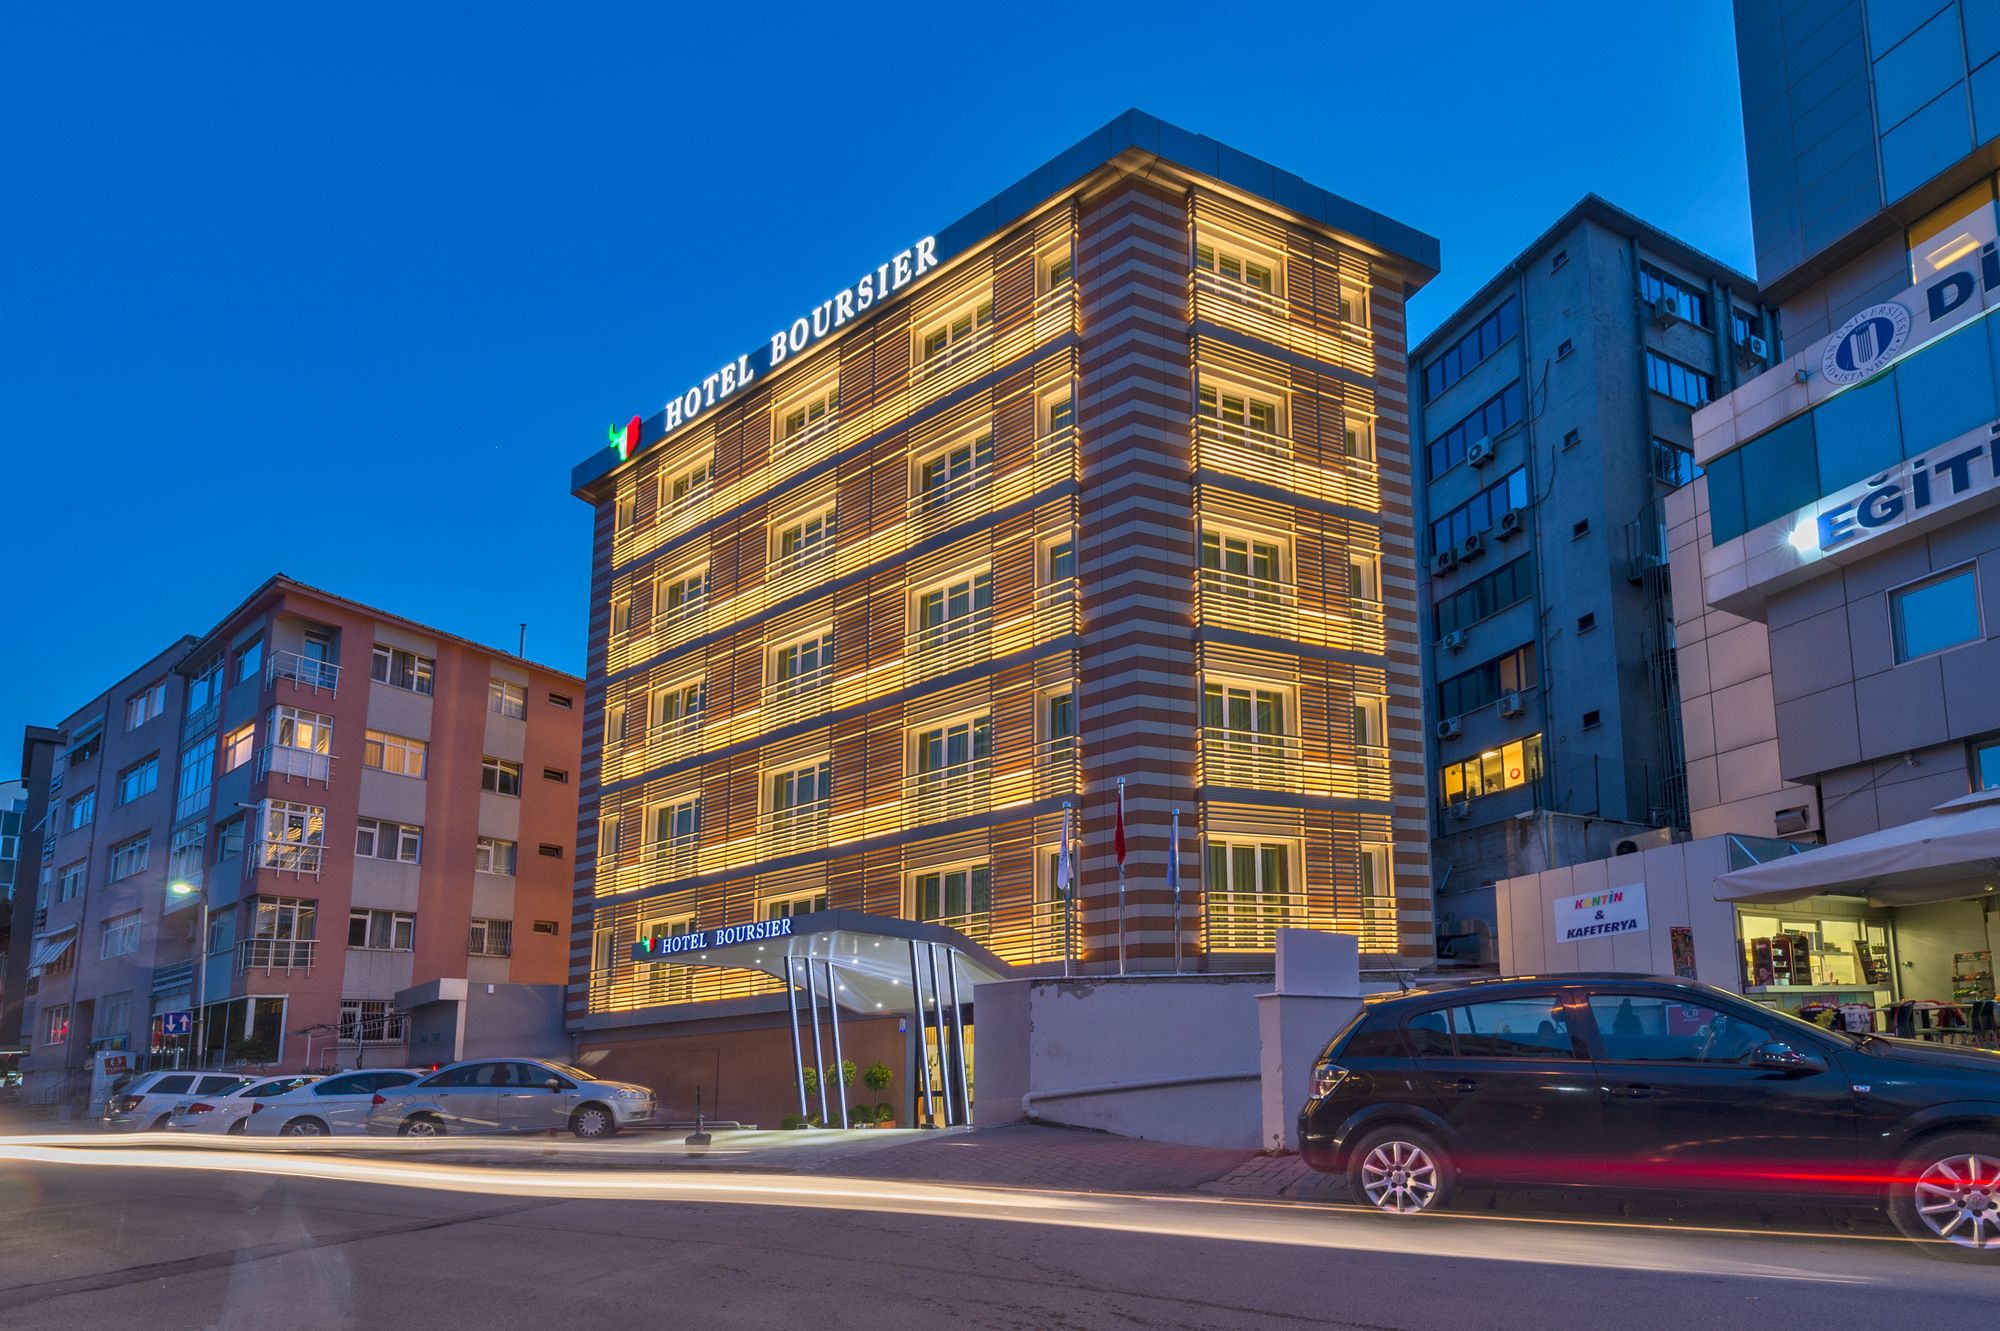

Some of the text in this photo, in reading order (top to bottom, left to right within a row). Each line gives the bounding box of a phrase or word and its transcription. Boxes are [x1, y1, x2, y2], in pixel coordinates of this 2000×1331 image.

[664, 235, 938, 432] HOTEL BOURSIER
[1574, 890, 1624, 910] KANTİN
[1594, 910, 1605, 920] &
[662, 918, 792, 954] HOTEL BOURSIER
[1567, 919, 1637, 939] KAFETERYA
